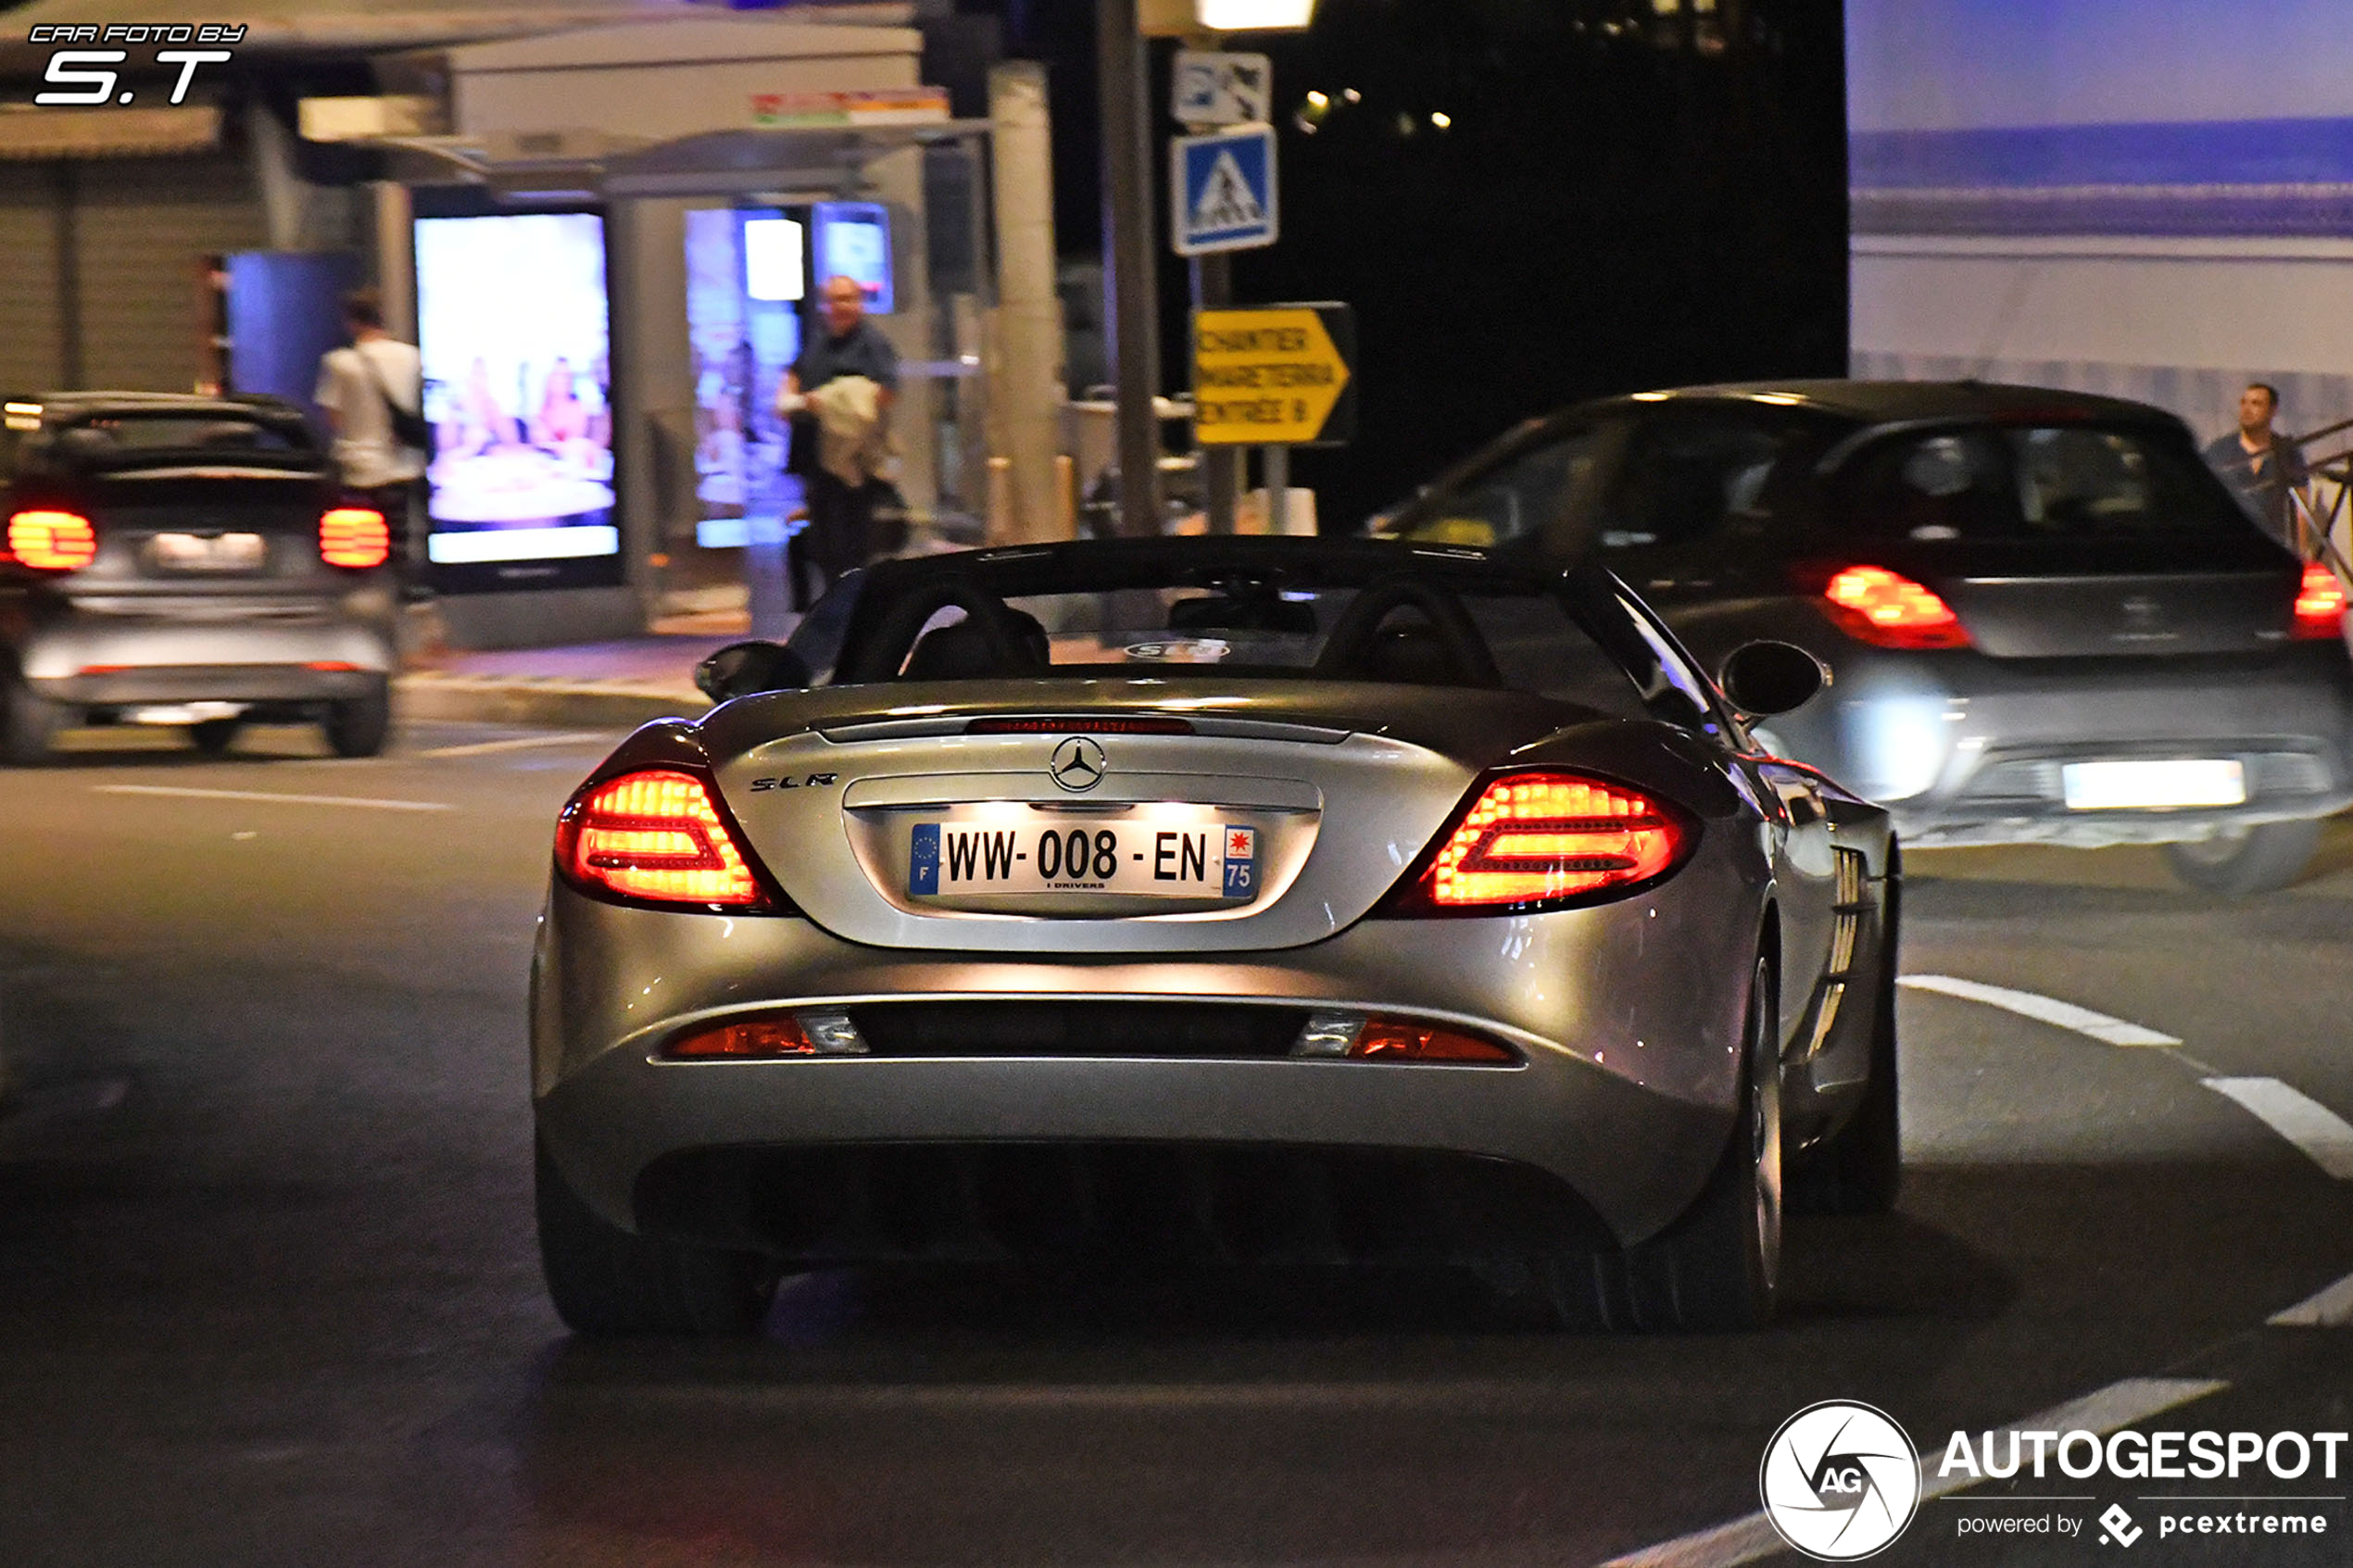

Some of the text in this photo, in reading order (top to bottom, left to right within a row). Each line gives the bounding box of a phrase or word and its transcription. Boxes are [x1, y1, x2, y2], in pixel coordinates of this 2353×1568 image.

[749, 772, 838, 792] SLR
[918, 866, 930, 881] F
[1227, 863, 1252, 888] 75
